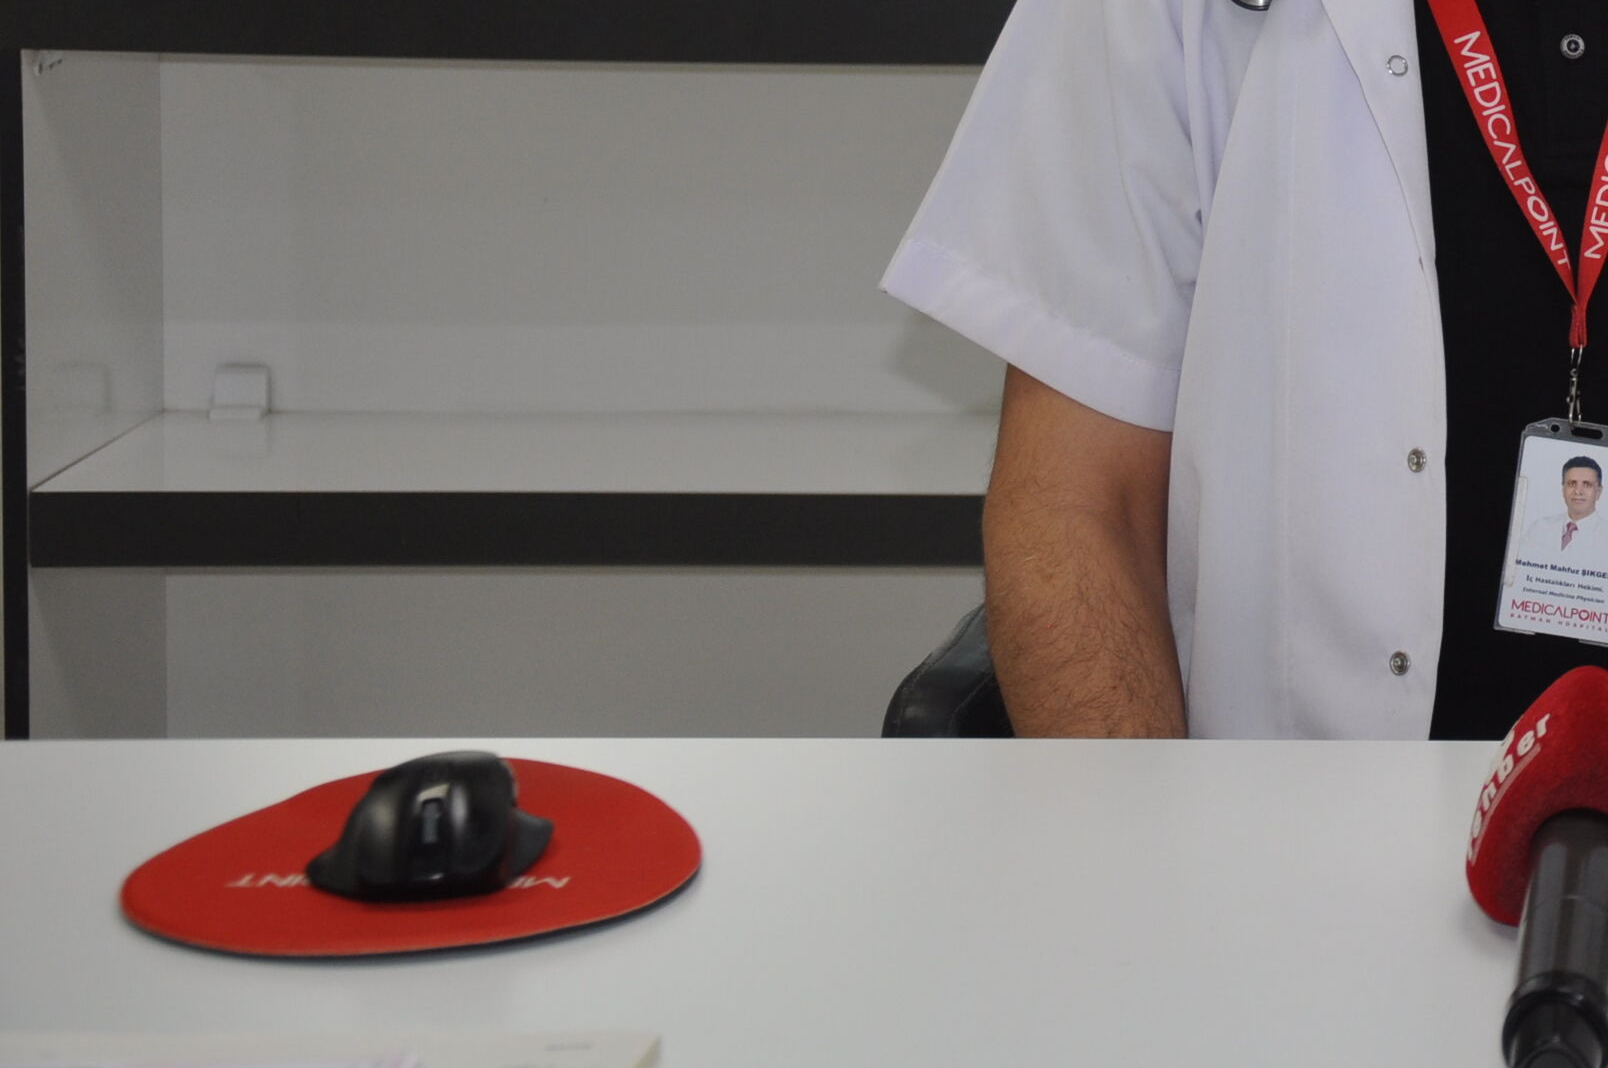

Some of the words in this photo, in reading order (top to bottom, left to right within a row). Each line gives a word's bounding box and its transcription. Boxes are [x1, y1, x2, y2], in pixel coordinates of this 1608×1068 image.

[1453, 30, 1572, 270] MEDICALPOINT
[1515, 558, 1548, 570] Mehmet
[1549, 563, 1580, 575] Mahfuz
